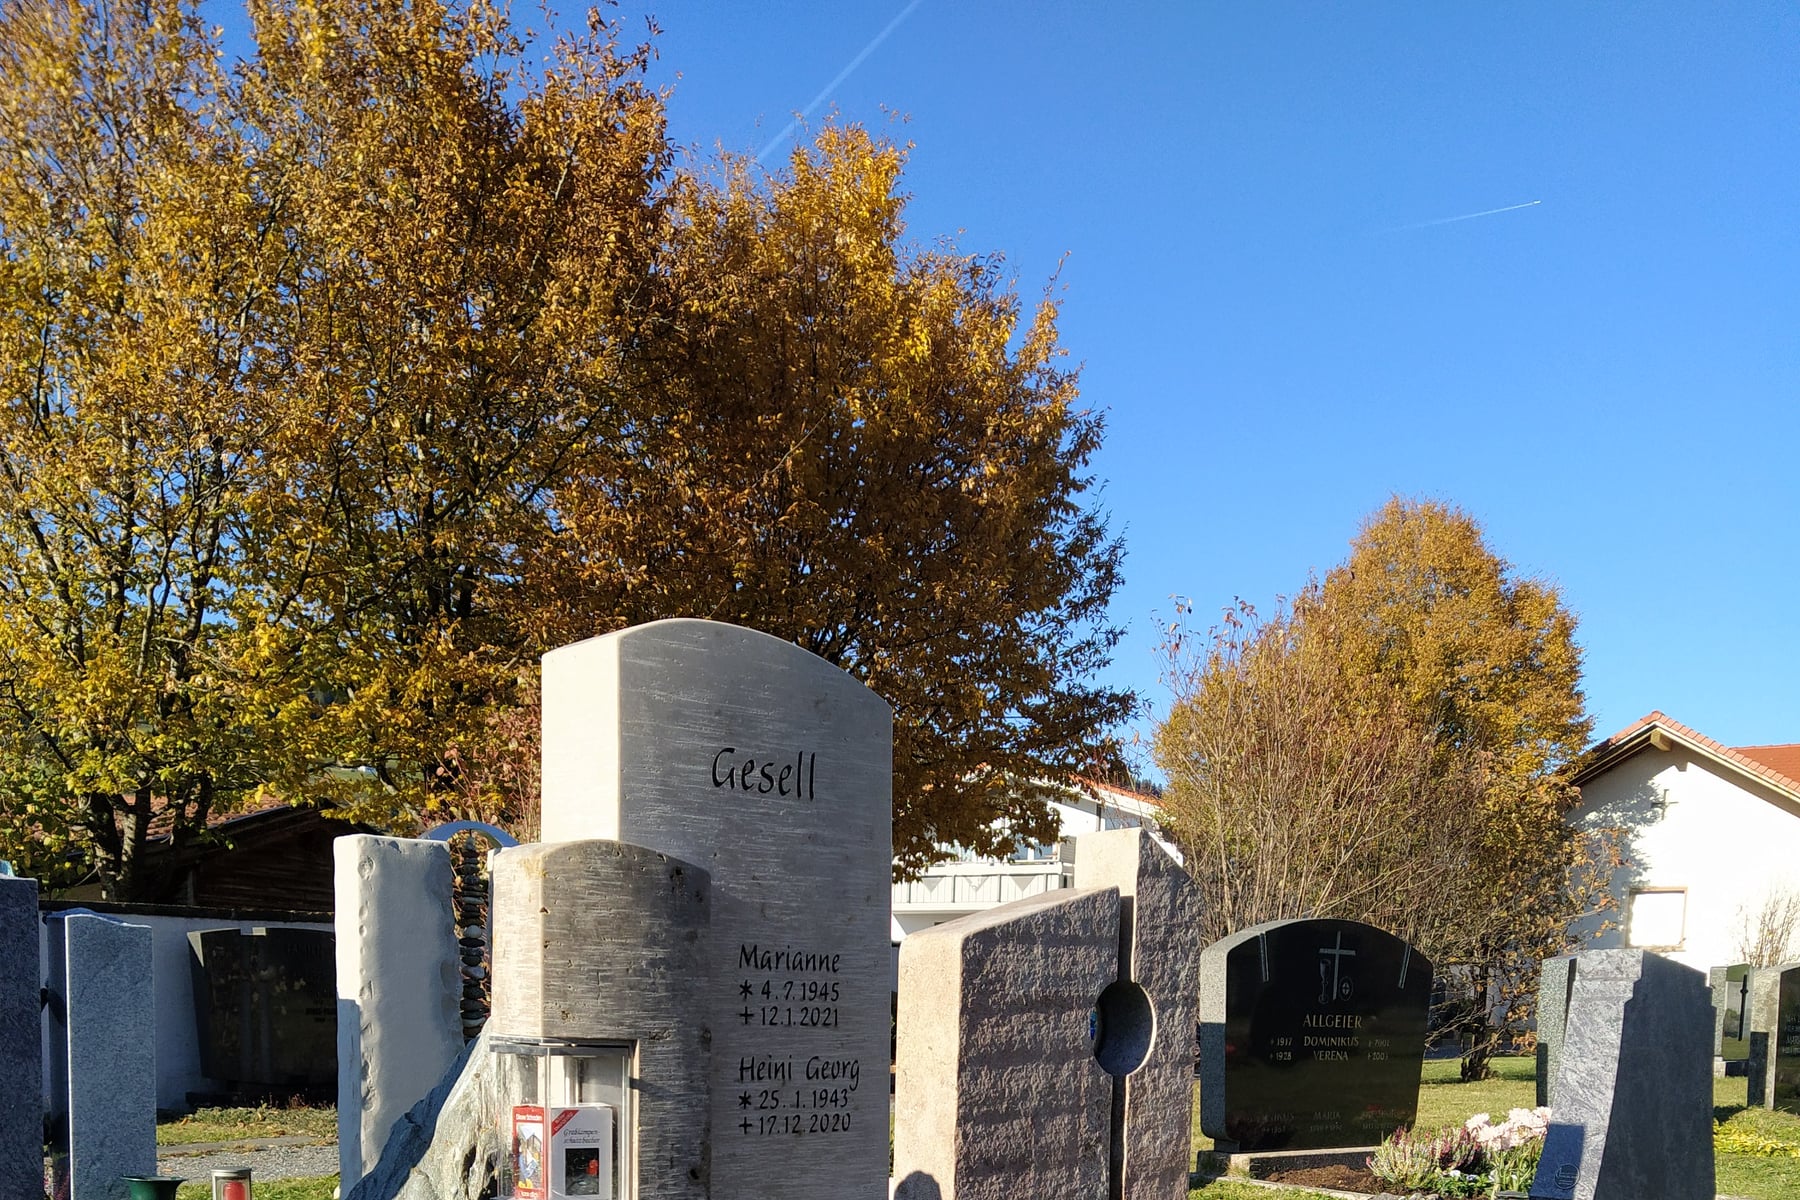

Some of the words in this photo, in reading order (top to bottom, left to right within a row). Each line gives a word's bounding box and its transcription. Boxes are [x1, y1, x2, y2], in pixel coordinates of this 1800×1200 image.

[712, 747, 816, 802] Gesell
[739, 944, 840, 973] Marianne
[1303, 1013, 1363, 1029] ALLGEIER
[1303, 1035, 1360, 1048] DOMINIKUS
[1313, 1050, 1349, 1061] VERENA
[739, 1054, 792, 1081] Heini
[805, 1055, 860, 1092] Georg
